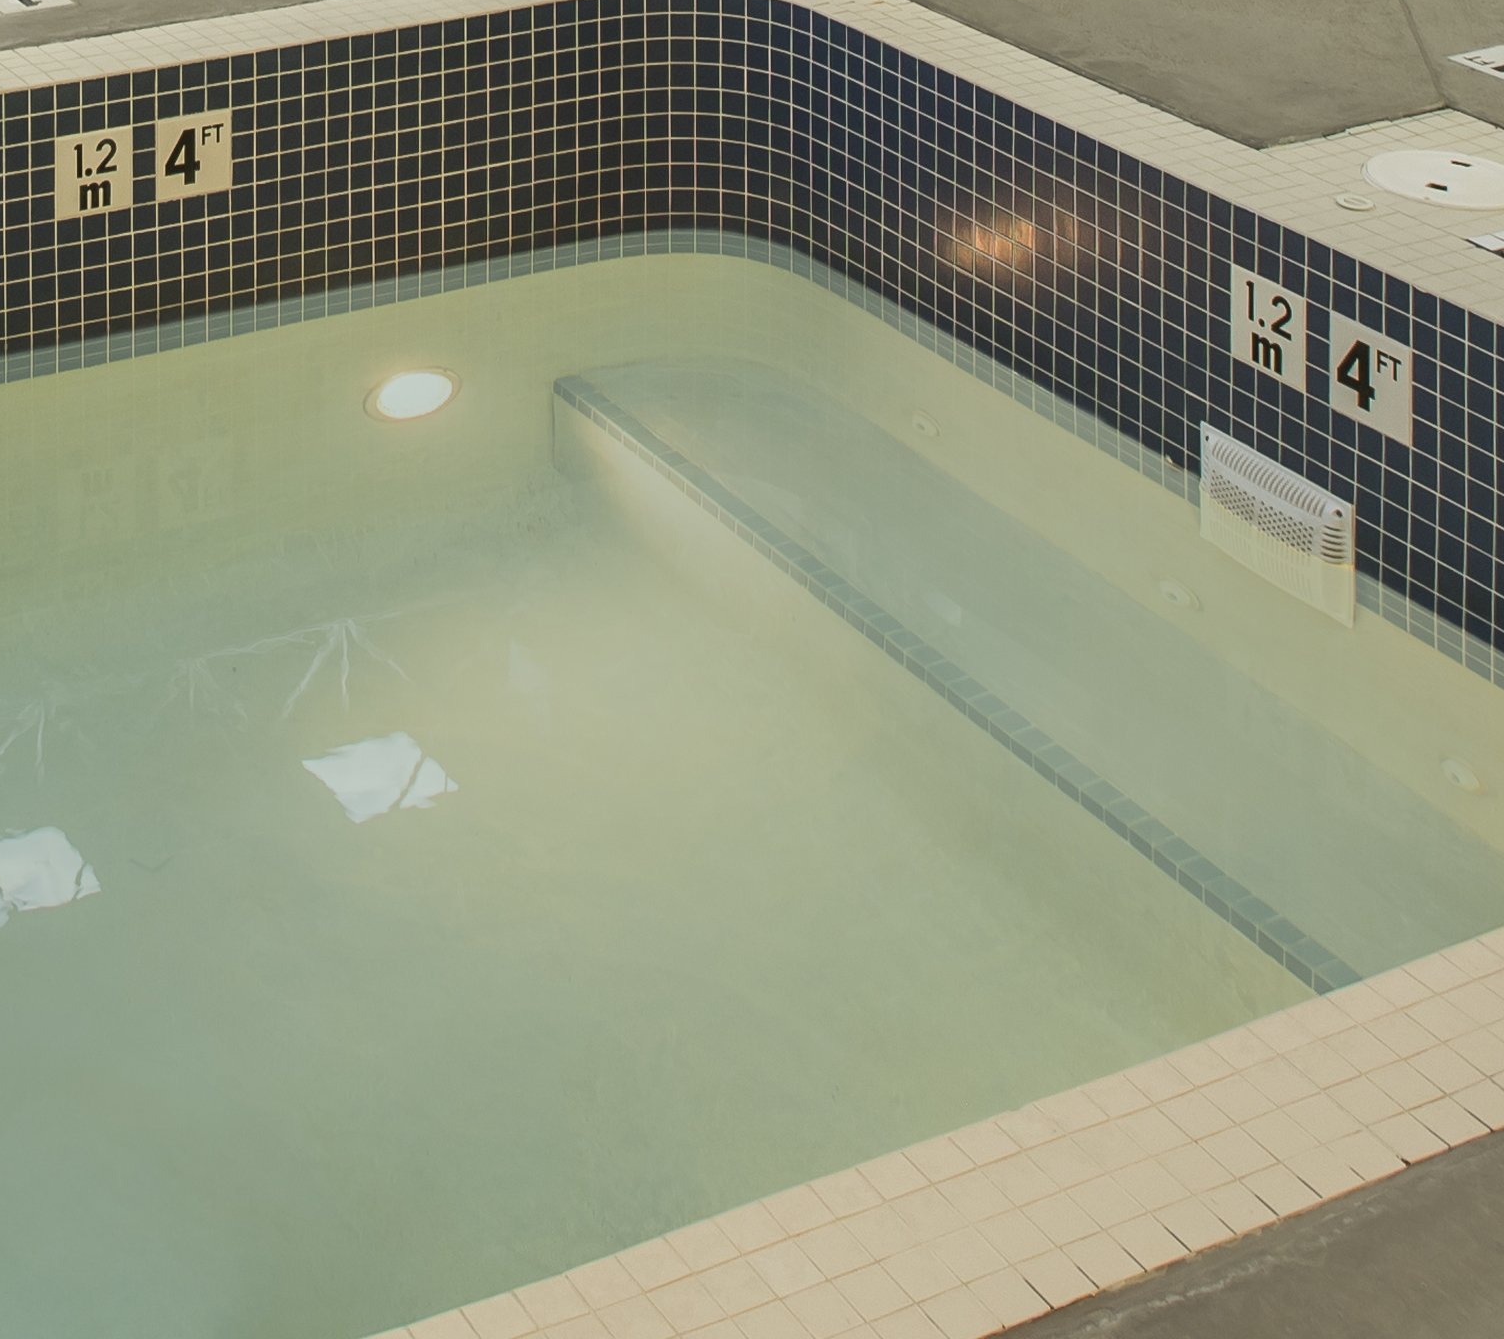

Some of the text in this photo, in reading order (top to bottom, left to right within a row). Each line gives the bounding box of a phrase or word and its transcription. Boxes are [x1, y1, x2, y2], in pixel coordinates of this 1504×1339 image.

[73, 139, 117, 178] 1.2
[79, 177, 111, 211] m
[1246, 280, 1292, 341] 1.2
[1251, 332, 1282, 376] m
